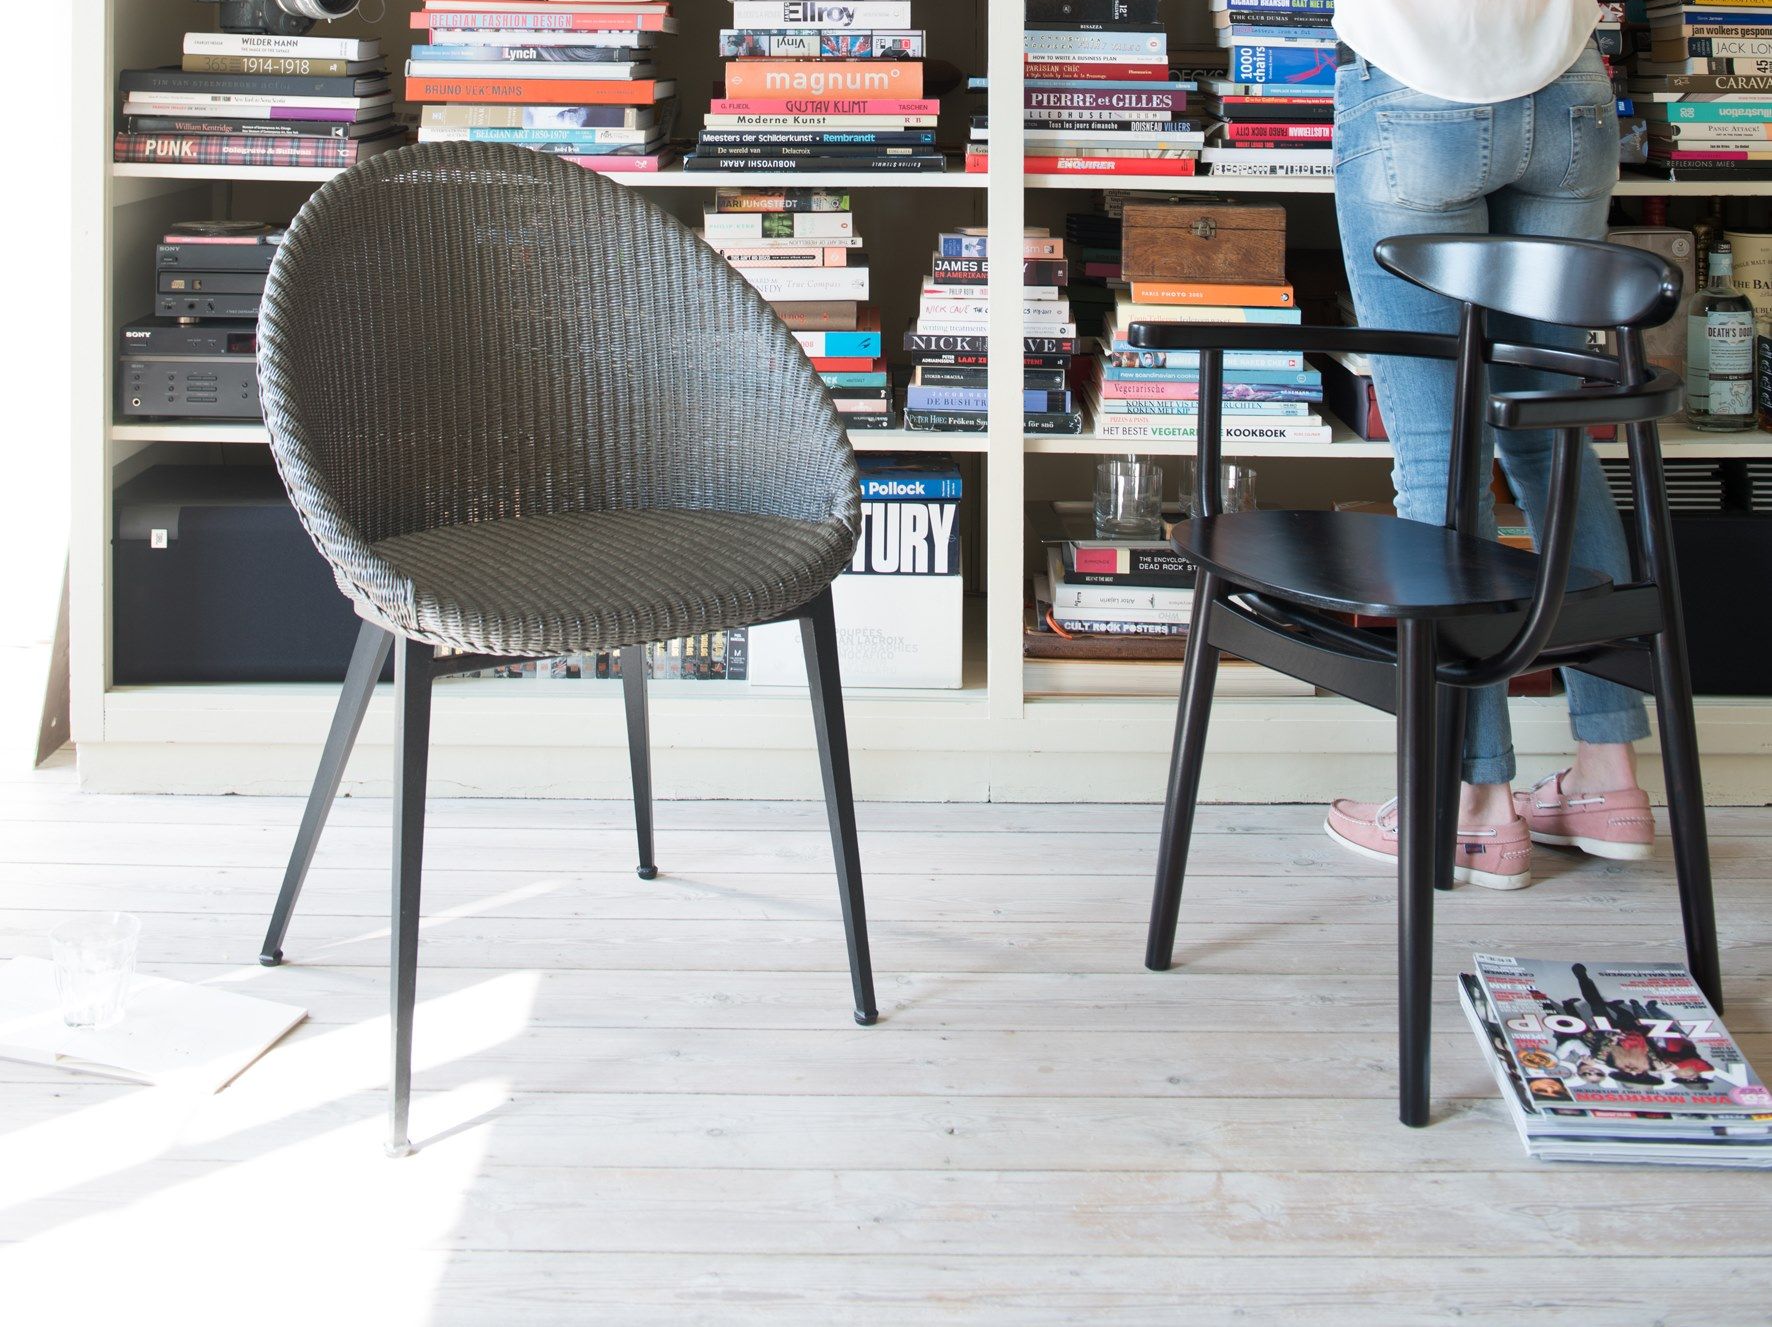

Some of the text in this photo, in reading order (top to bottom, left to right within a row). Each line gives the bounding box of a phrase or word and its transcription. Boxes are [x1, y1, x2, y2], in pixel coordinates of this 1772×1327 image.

[1310, 0, 1324, 8] NIET
[789, 2, 857, 26] Ellroy
[431, 14, 572, 27] BELGIAN FASHION DESIGN
[1692, 25, 1739, 36] jan wolkers
[241, 38, 298, 47] WILDER MANN
[776, 36, 805, 48] Vinyl
[505, 48, 536, 60] Lynch
[1716, 43, 1745, 54] JACK
[243, 58, 309, 74] 1914-1918
[1240, 48, 1252, 79] 1000
[1253, 46, 1265, 82] chairs
[766, 69, 889, 95] magnum
[1031, 93, 1172, 108] PIERRE et GILLES
[785, 101, 868, 113] GUSTAV KLIMT
[737, 116, 826, 124] Moderne Kunst
[1131, 120, 1190, 132] DOISNEAU VILLERS
[175, 122, 233, 133] William Kentridge
[703, 133, 812, 142] Meesters der Schilderkunst
[823, 134, 875, 142] Rembrandt
[145, 140, 197, 156] PUNK.
[222, 146, 266, 154] Colegrave
[276, 147, 311, 155] Sullivan
[720, 160, 796, 168] NOBUYOSHI ARAKI
[935, 261, 978, 271] JAMES
[922, 325, 948, 333] writing
[1708, 327, 1753, 337] DEATH'S DOOR
[912, 336, 971, 350] NICK
[1114, 383, 1165, 395] Vegetarische
[1103, 426, 1286, 437] HET BESTE KOOKBOEK
[869, 482, 925, 495] Pollock
[853, 503, 956, 573] TURY
[1064, 622, 1167, 634] CULT ROCK POSTERS
[1508, 1015, 1723, 1038] ZZ TOP
[1575, 1093, 1732, 1104] VAN MORRISON
